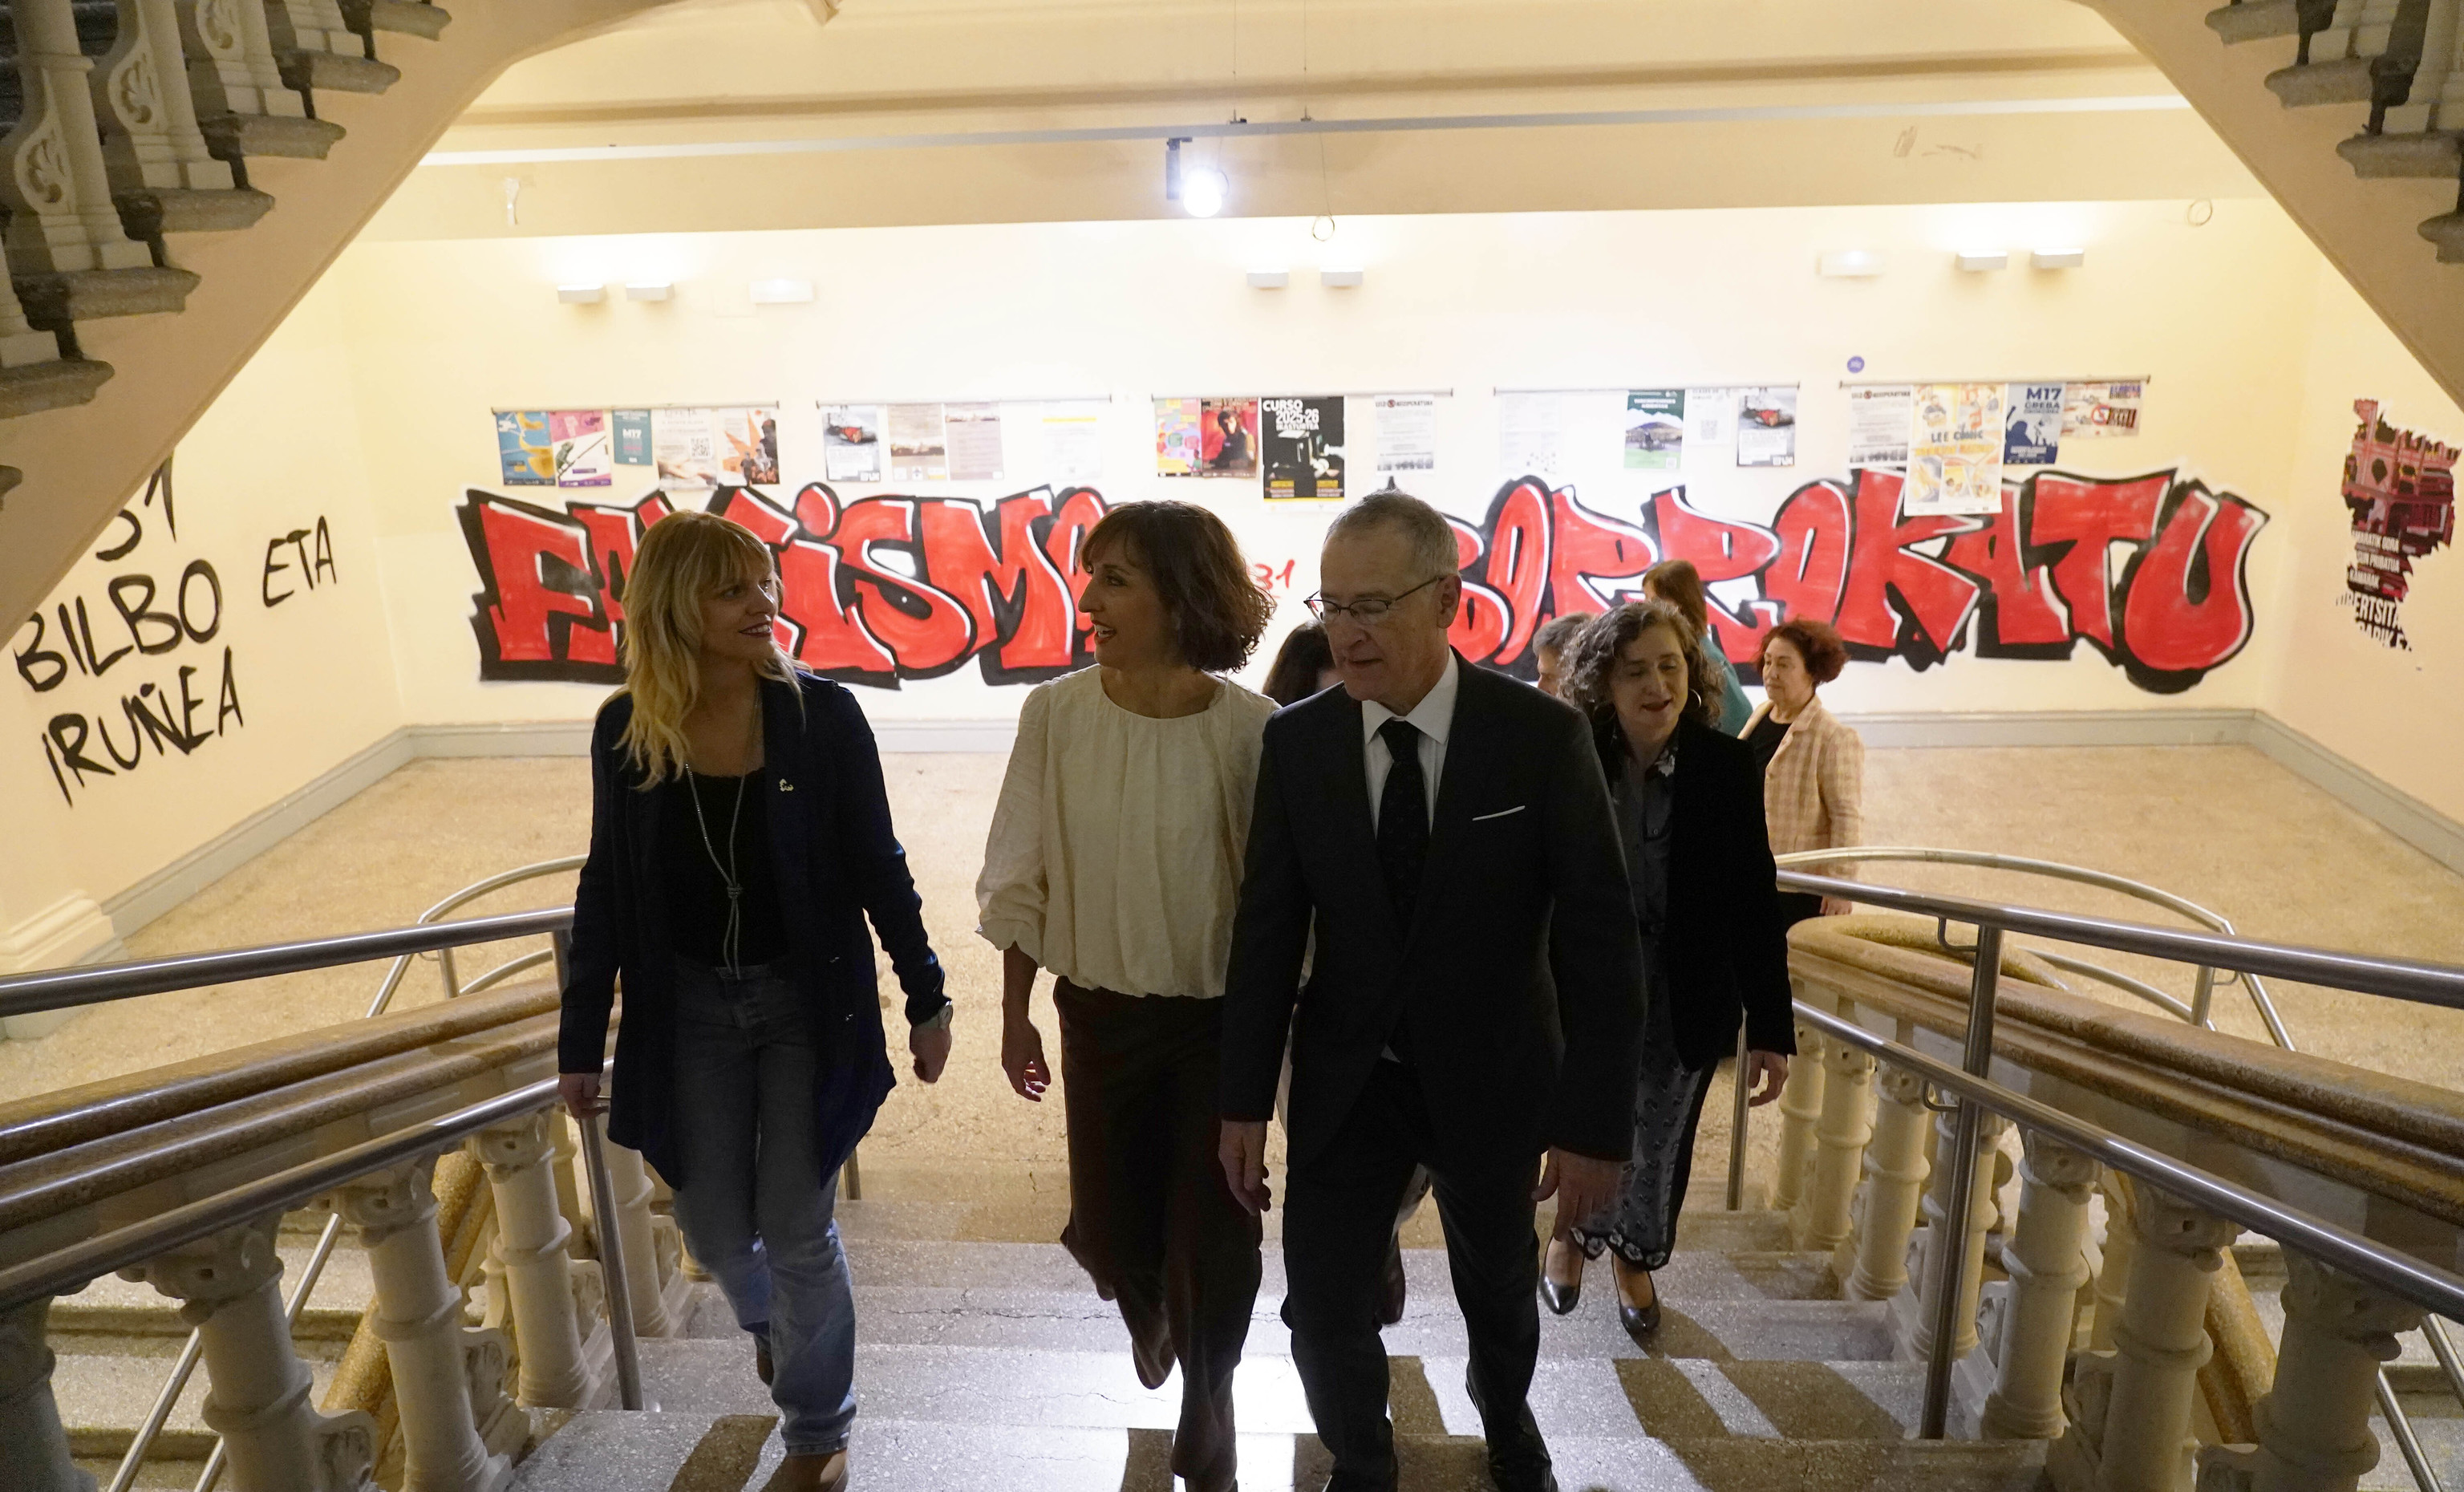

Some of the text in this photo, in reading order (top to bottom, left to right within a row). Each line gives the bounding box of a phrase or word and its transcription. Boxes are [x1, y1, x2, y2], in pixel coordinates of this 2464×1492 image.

[2026, 387, 2062, 400] M17
[1262, 399, 1304, 412] CURSO
[1275, 408, 1319, 424] 2025-26
[14, 515, 337, 692] BILBO ETA
